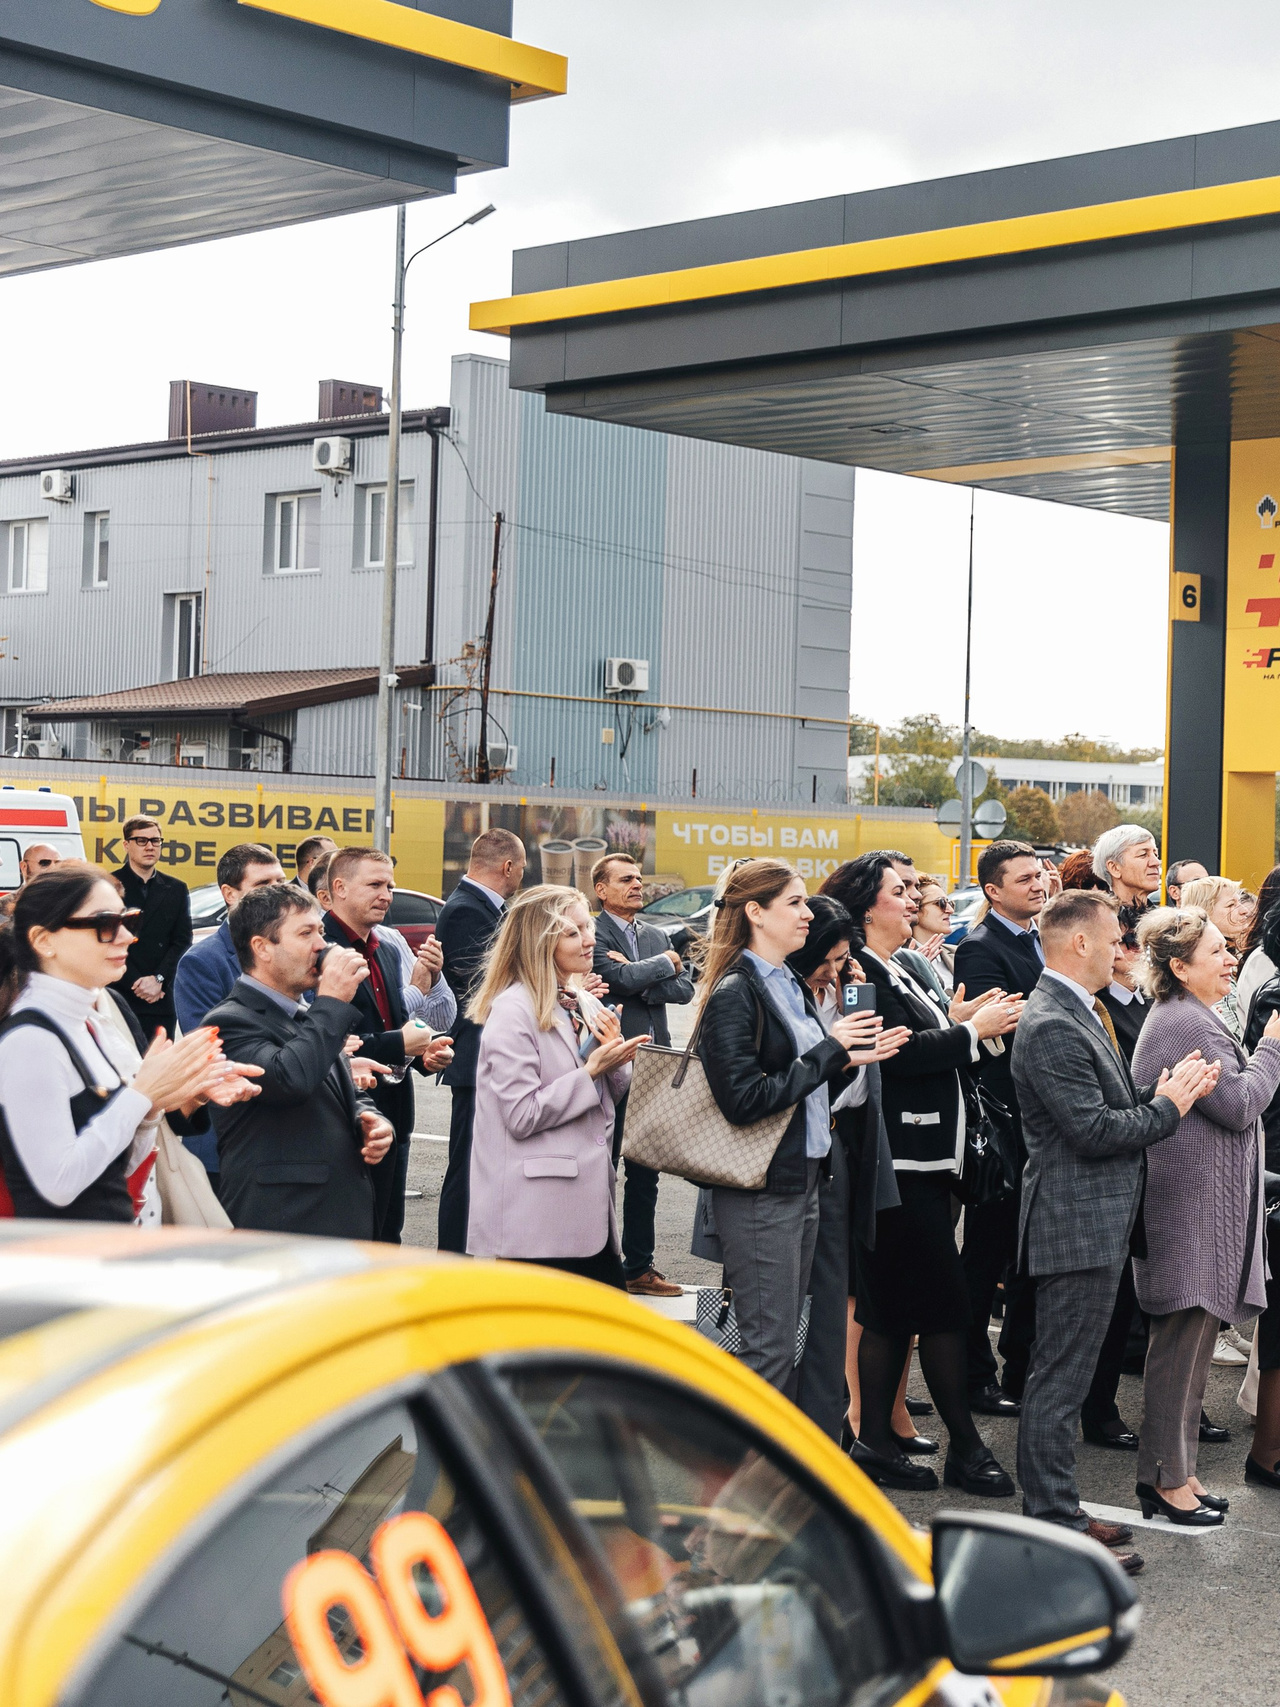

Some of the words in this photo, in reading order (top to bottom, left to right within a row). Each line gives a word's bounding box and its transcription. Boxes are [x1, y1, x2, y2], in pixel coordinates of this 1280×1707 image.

[1182, 584, 1197, 609] 6
[673, 822, 774, 848] ЧТОБЫ
[780, 826, 839, 850] ВАМ
[95, 837, 217, 867] КФЕ
